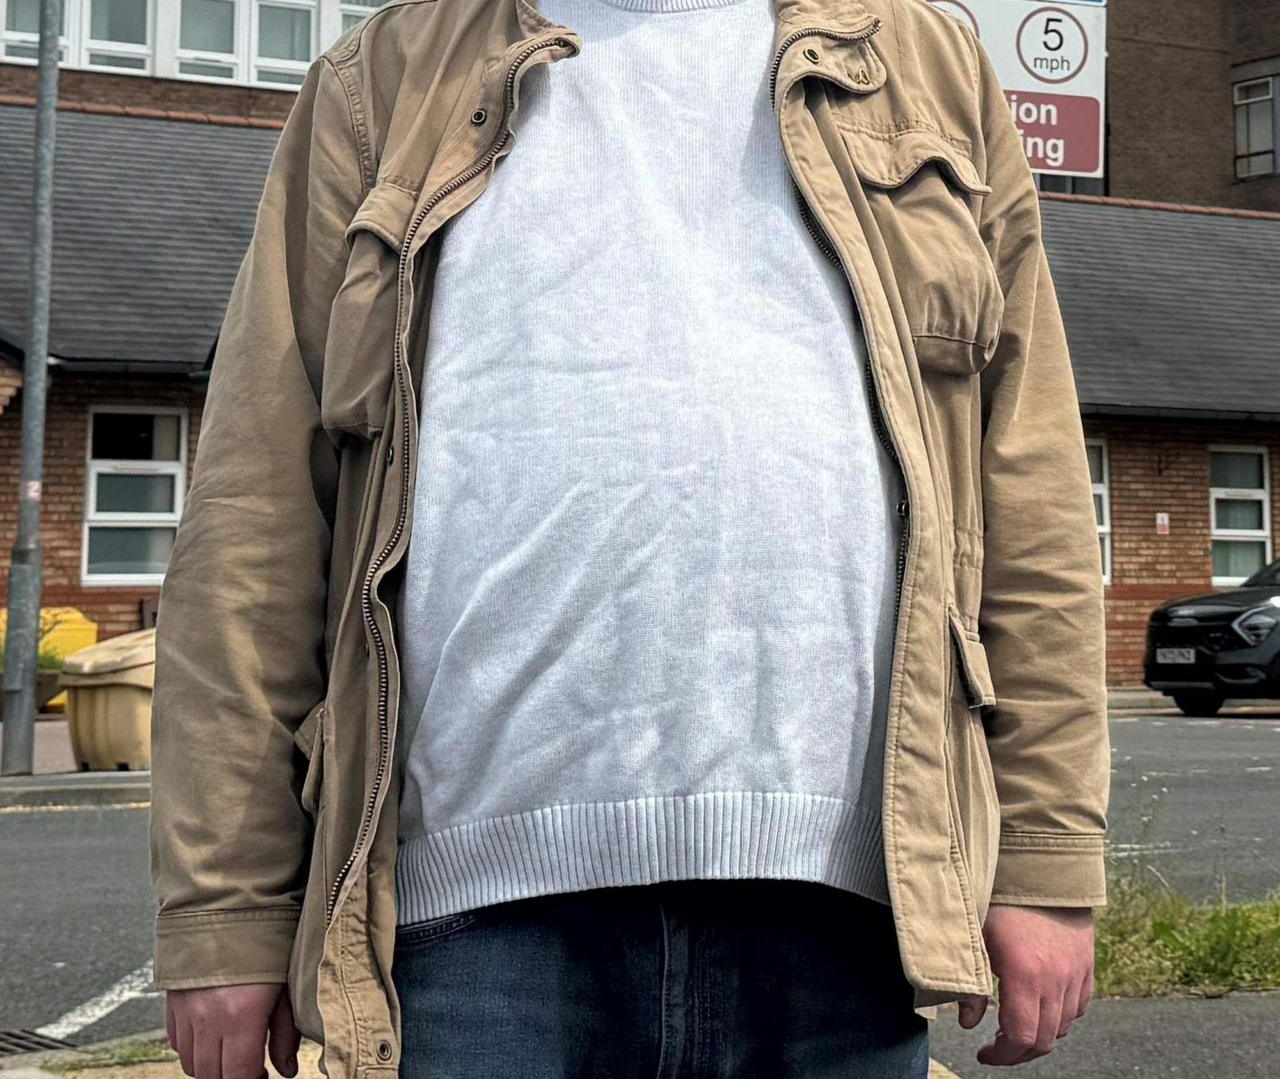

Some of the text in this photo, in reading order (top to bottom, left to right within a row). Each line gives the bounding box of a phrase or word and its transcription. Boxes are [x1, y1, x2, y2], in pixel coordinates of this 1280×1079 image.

[1042, 18, 1064, 52] 5
[1033, 55, 1071, 73] mph
[1010, 94, 1058, 126] ion
